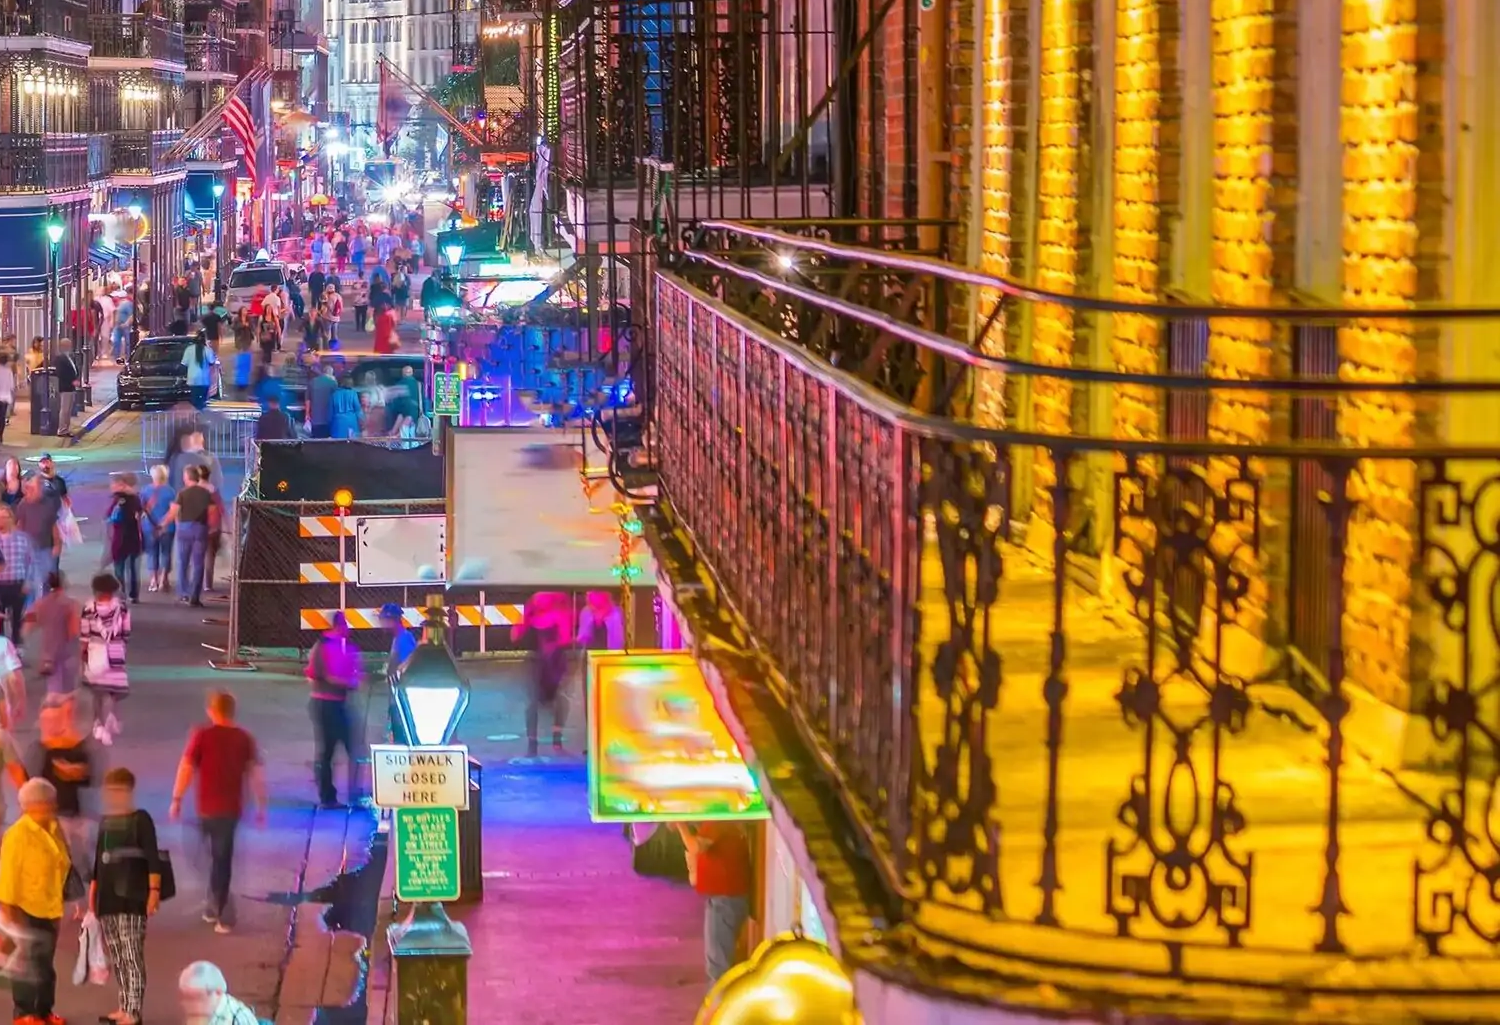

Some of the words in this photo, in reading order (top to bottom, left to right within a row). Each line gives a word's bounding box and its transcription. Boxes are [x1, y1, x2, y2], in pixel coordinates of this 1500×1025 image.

[386, 755, 453, 766] SIDEWALK
[393, 773, 446, 784] CLOSED
[403, 791, 438, 803] HERE
